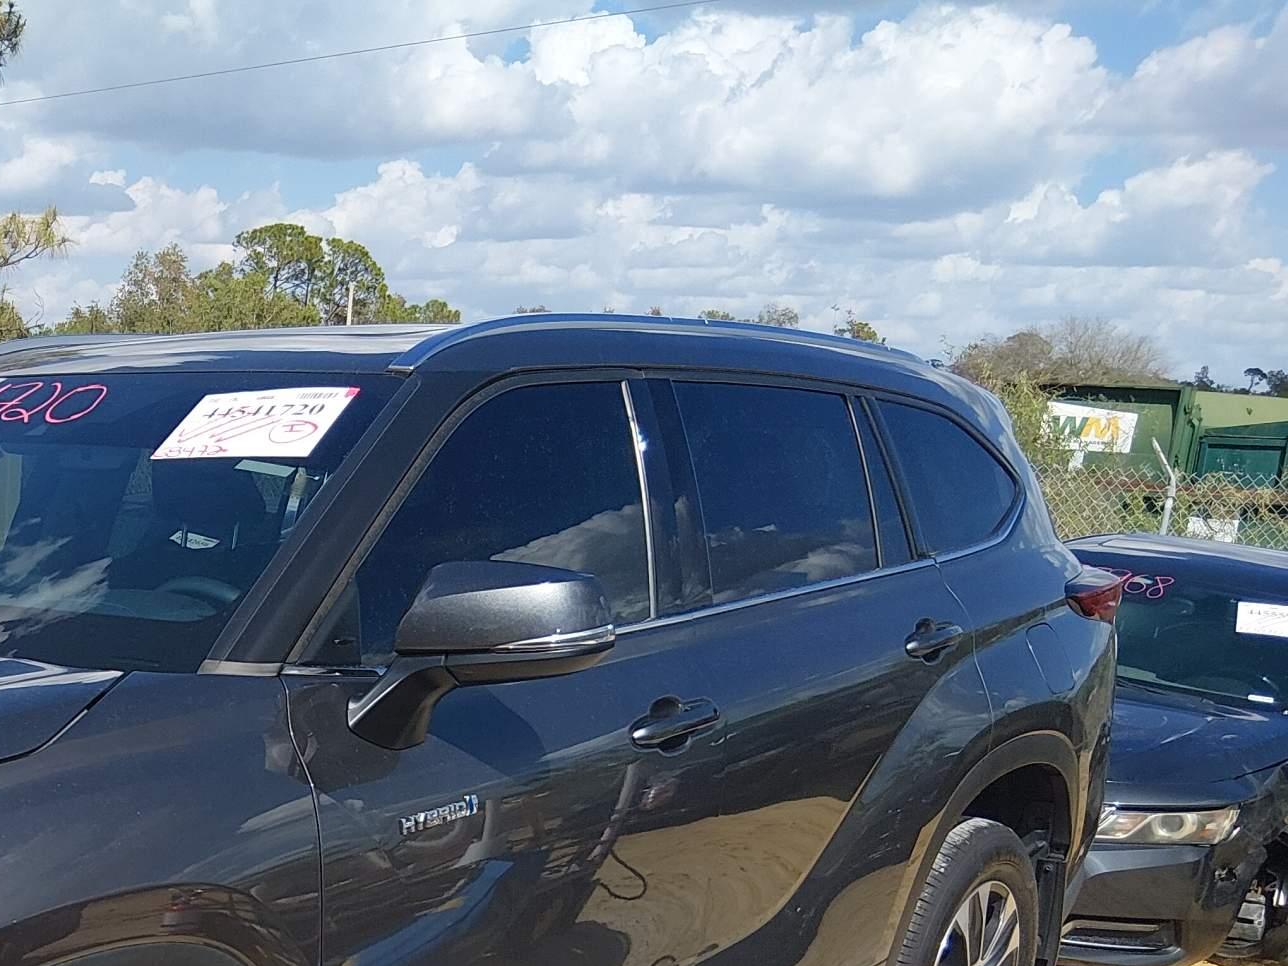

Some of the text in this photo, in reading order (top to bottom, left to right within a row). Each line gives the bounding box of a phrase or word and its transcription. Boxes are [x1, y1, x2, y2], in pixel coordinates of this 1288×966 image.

[202, 403, 326, 419] 44541720
[1050, 414, 1121, 440] WM
[400, 801, 467, 835] HYBRID
